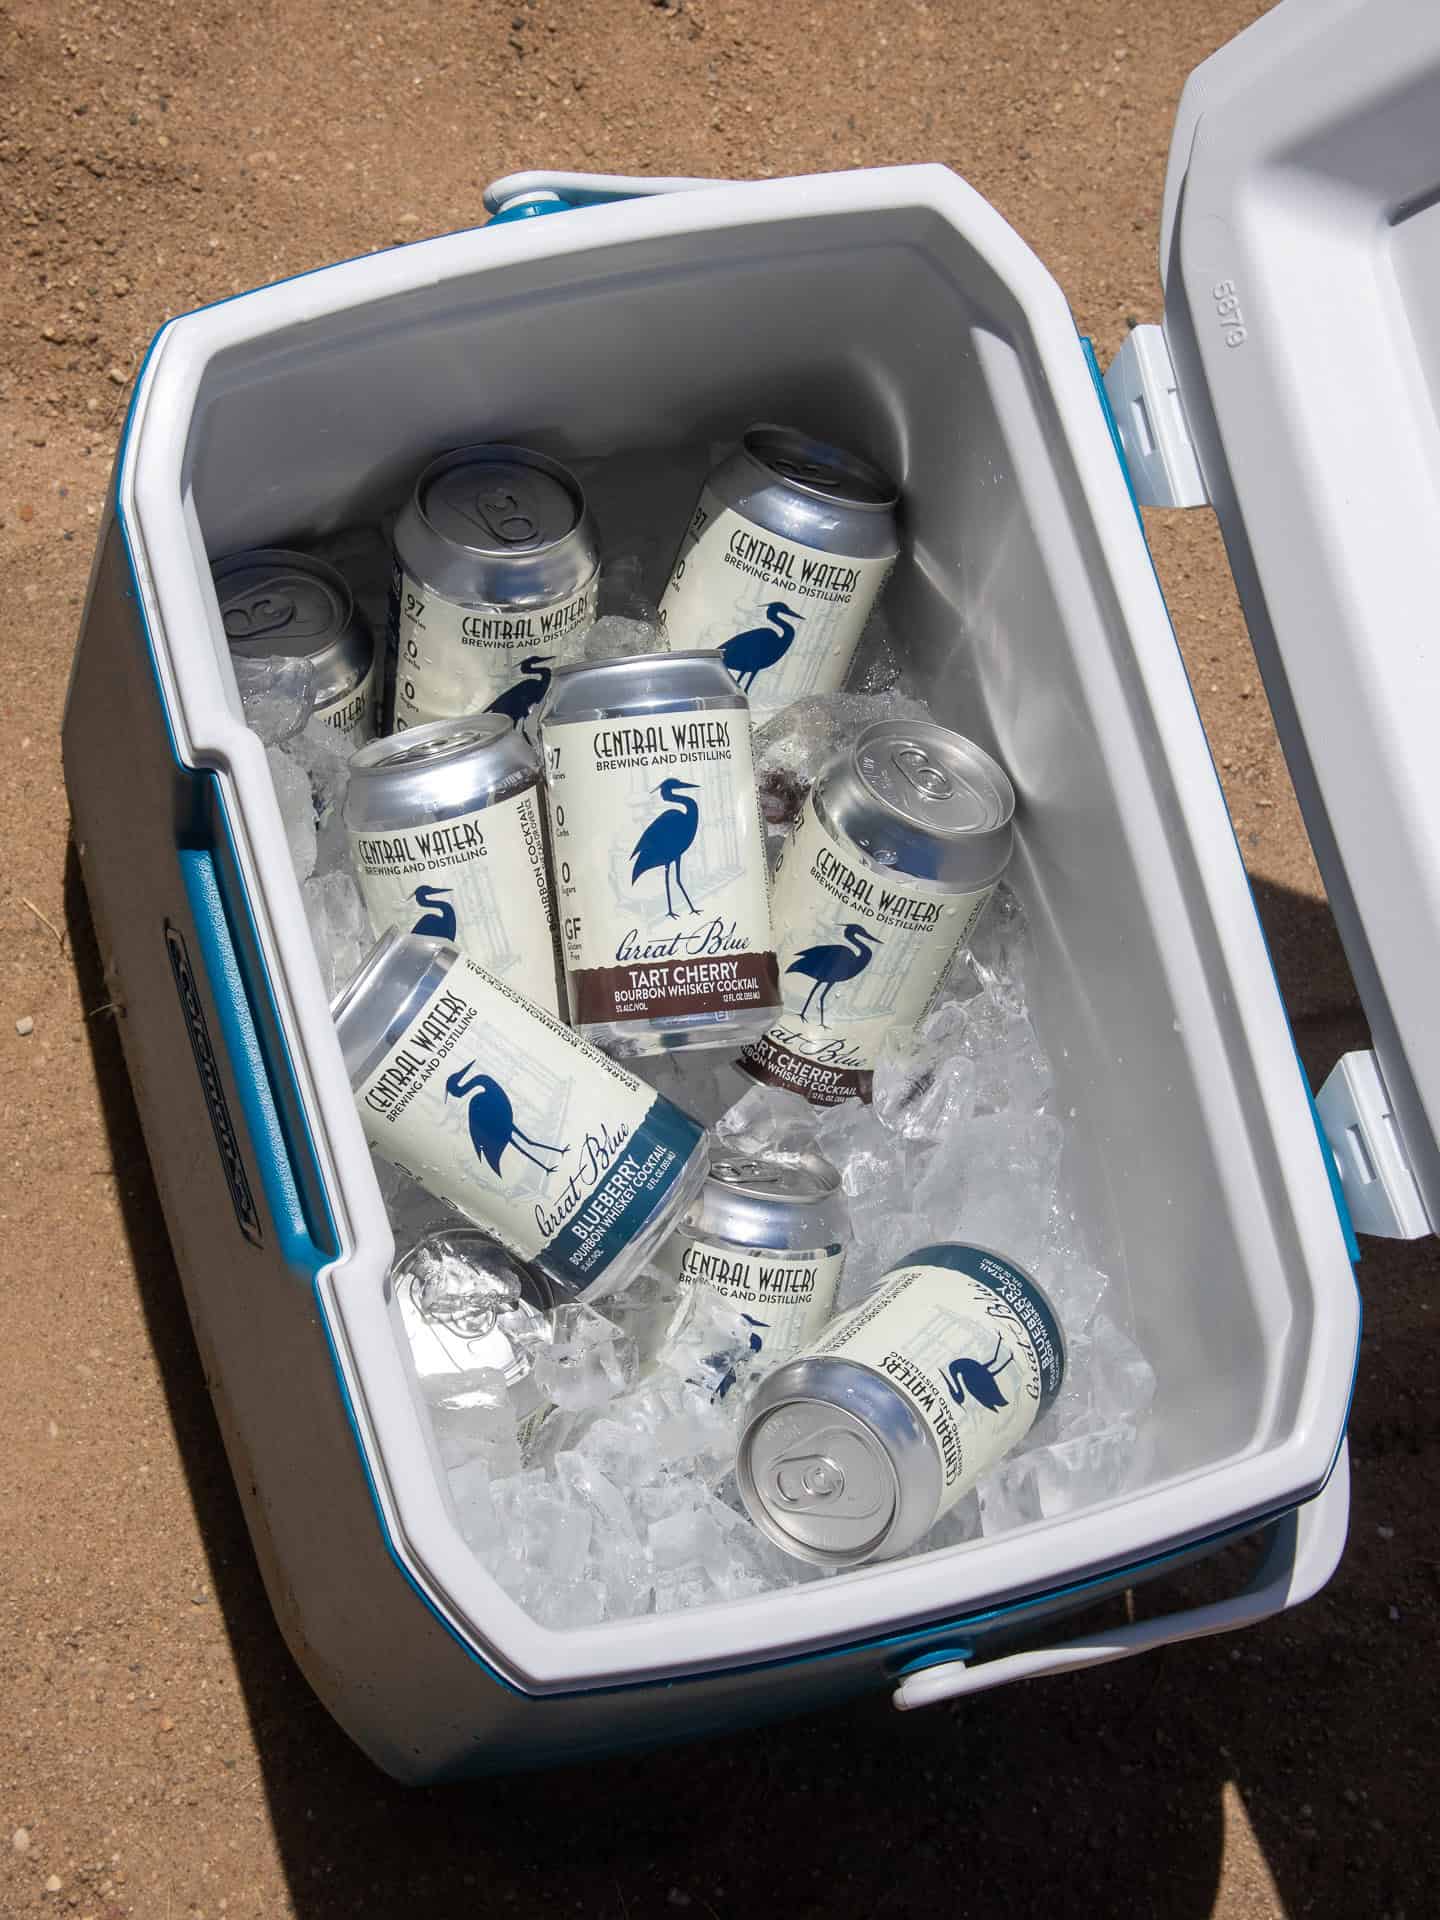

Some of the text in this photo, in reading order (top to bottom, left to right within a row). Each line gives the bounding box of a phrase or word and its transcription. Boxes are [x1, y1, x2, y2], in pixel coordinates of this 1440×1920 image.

[724, 553, 853, 604] BREWING AND DISTILLING
[730, 529, 795, 580] CENTRAL
[802, 560, 862, 593] WATERS
[407, 594, 425, 617] 97
[462, 616, 536, 641] CENTRAL
[541, 591, 589, 635] WATERS
[461, 637, 515, 649] BREWING
[516, 638, 541, 649] AND
[594, 721, 731, 758] CENTRAL WATERS
[596, 749, 732, 771] BREWING AND DISTILLING
[516, 801, 540, 866] COCKTAIL
[556, 805, 565, 826] 0
[358, 820, 484, 865] CENTRAL WATERS
[365, 847, 488, 876] BREWING AND DISTILLING
[562, 862, 570, 883] 0
[816, 848, 944, 923] CENTRAL WATERS
[810, 866, 934, 932] BREWING AND DISTILLING
[565, 918, 581, 940] GF
[615, 916, 750, 961] Great Blue
[614, 977, 760, 1002] BOURBON WHISKEY COCKTAIL
[629, 961, 739, 988] TART CHERRY
[465, 959, 640, 1092] SPARKLING BOURBON COCKTAIL
[365, 989, 467, 1112] CENTRAL WATERS
[385, 1007, 478, 1122] BREWING AND DISTILLING
[777, 1054, 843, 1086] CHERRY
[767, 1062, 811, 1087] WHISKEY
[811, 1082, 857, 1096] COCKTAIL
[535, 1122, 629, 1237] Great Blue
[571, 1154, 640, 1240] BLUEBERRY
[569, 1227, 607, 1265] BOURBON
[601, 1186, 637, 1228] WHISKEY
[633, 1144, 667, 1187] COCKTAIL
[682, 1247, 751, 1289] CENTRAL
[759, 1266, 818, 1293] WATERS
[980, 1262, 1022, 1297] COCKTAIL
[730, 1290, 756, 1302] AND
[758, 1293, 812, 1304] DISTILLING
[1022, 1297, 1048, 1340] WHISKEY
[996, 1285, 1050, 1370] BLUEBERRY
[890, 1351, 940, 1396] DISTILLING
[878, 1356, 957, 1486] CENTRAL WATERS
[938, 1397, 954, 1421] AND
